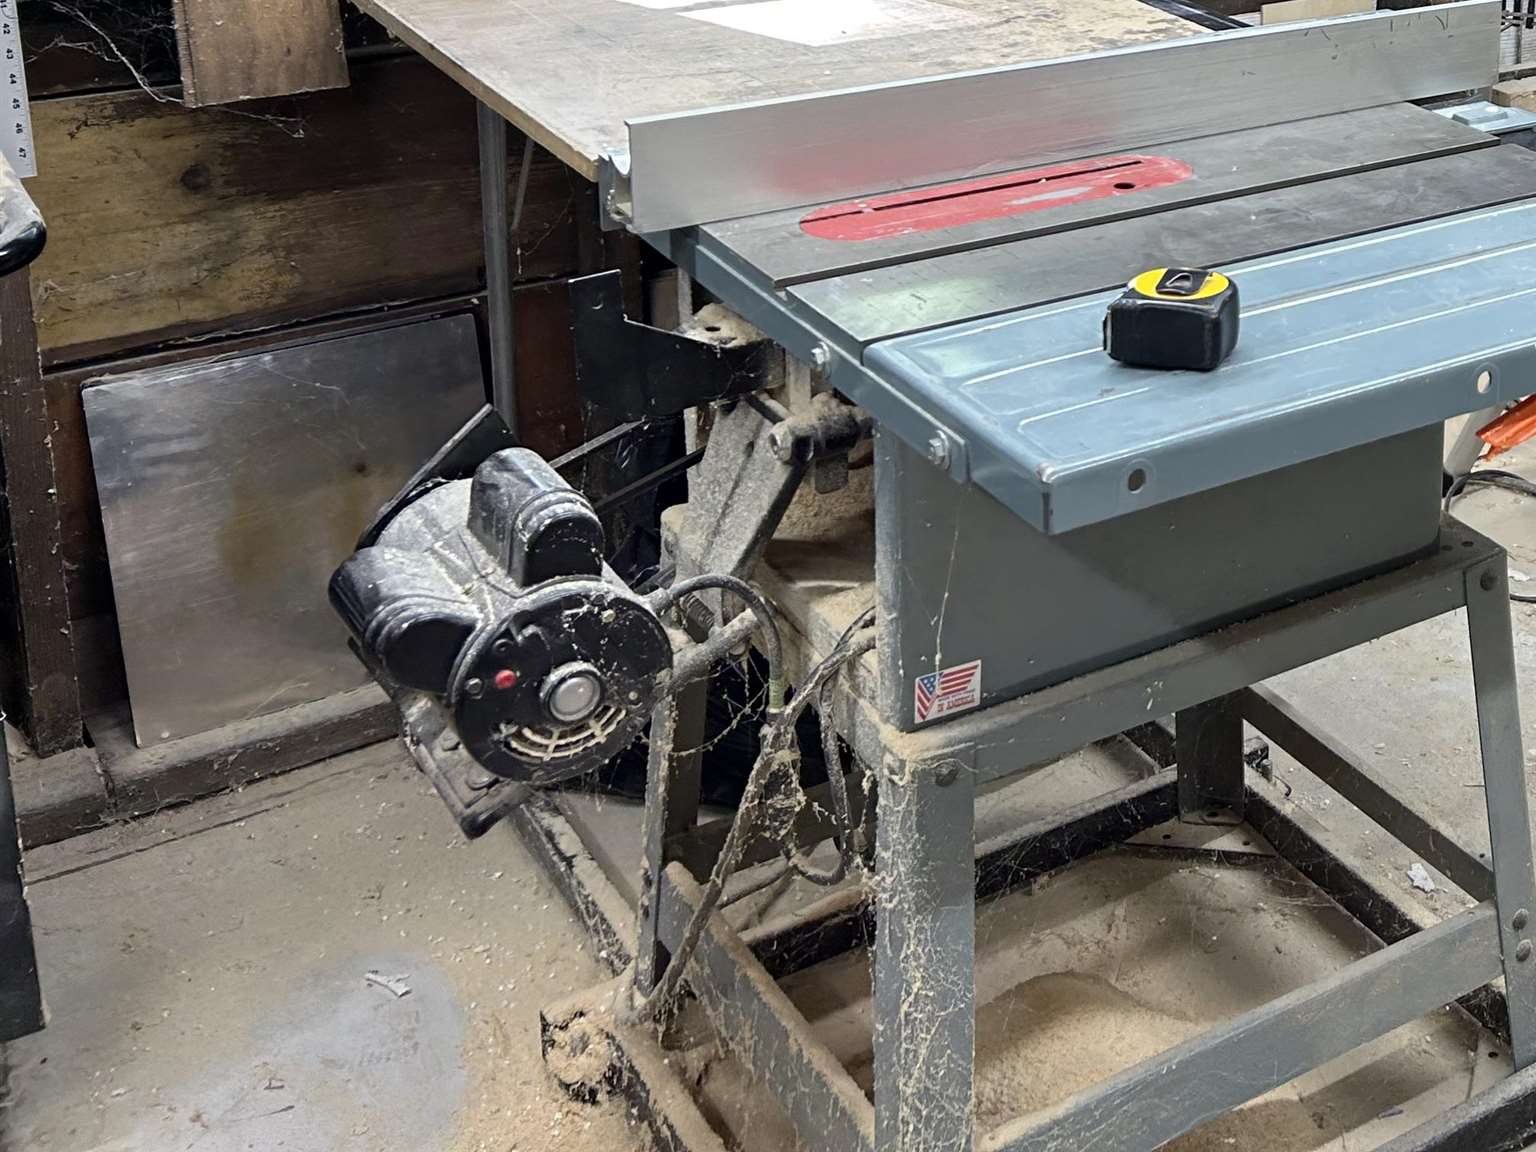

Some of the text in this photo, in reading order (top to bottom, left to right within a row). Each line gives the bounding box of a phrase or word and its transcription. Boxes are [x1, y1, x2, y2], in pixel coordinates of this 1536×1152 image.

[3, 23, 11, 35] 42
[6, 48, 14, 60] 43
[9, 73, 17, 85] 44
[12, 98, 20, 110] 45
[15, 122, 23, 134] 46
[19, 147, 27, 159] 47
